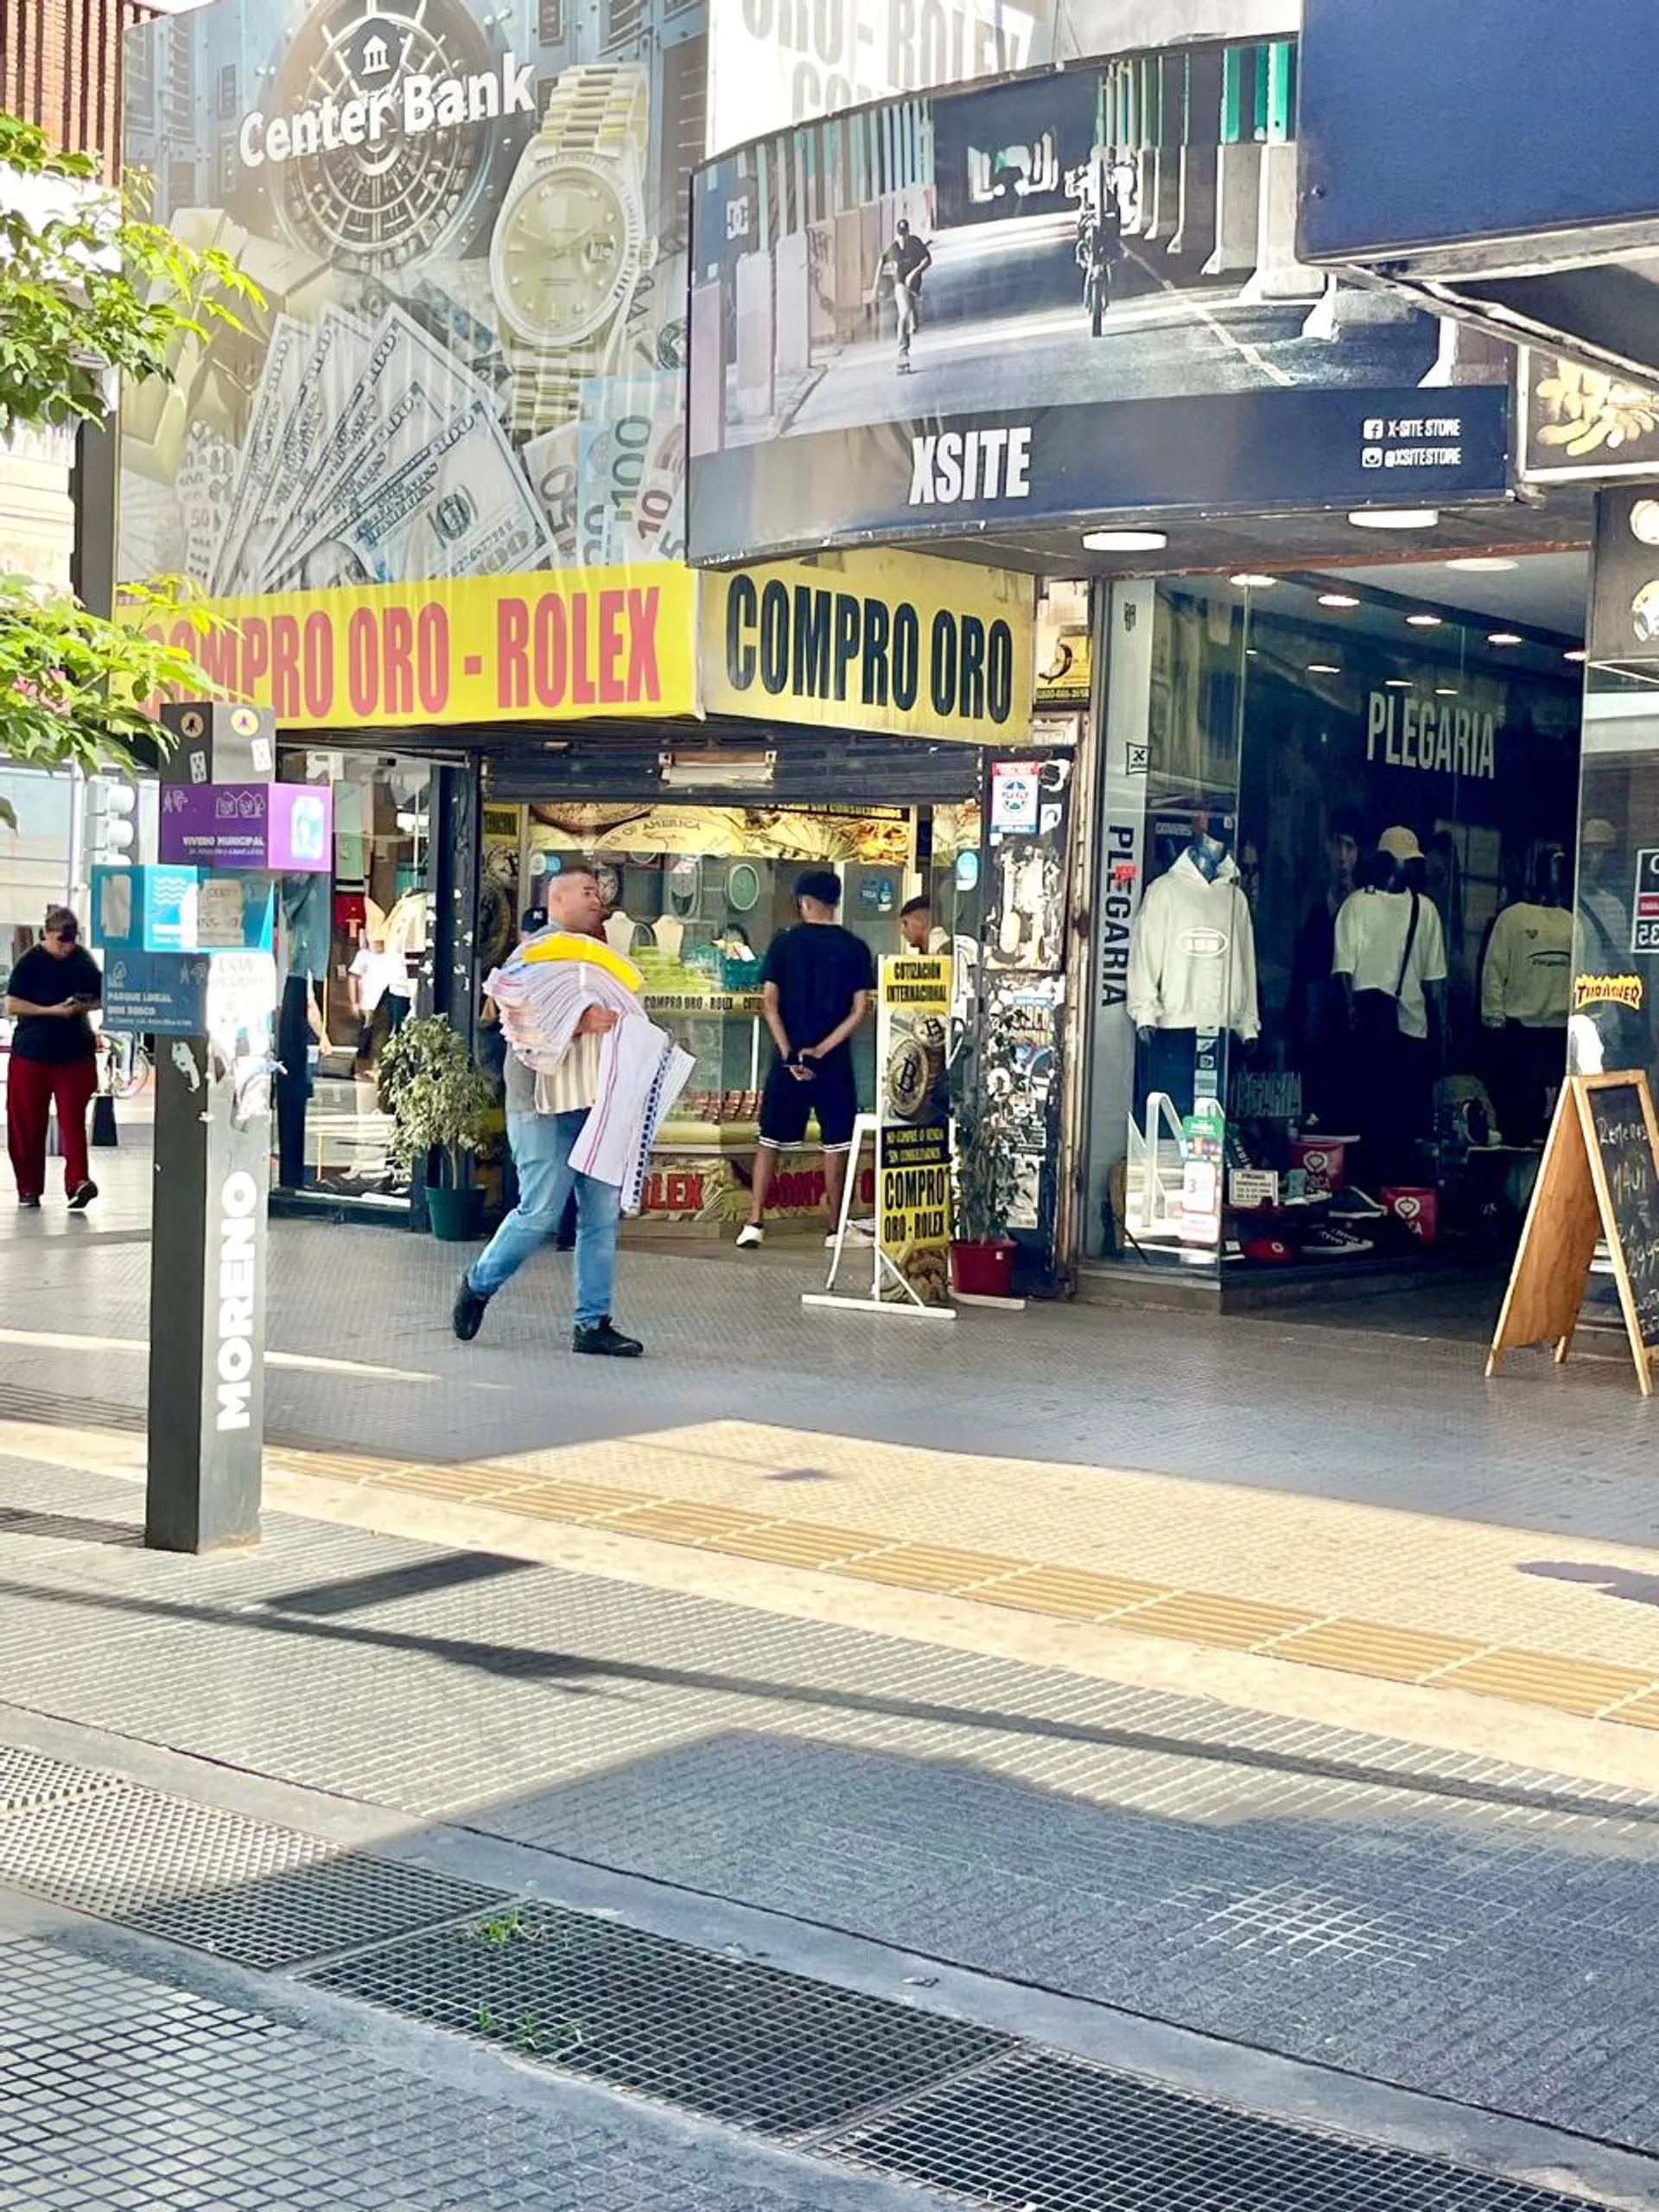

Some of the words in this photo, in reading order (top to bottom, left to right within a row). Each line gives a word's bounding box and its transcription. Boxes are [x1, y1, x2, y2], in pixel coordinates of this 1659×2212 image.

[239, 87, 393, 167] Center
[404, 53, 536, 133] Bank
[909, 427, 1031, 505] XSITE
[1388, 418, 1423, 438] X-SITE
[1425, 418, 1461, 437] STORE
[348, 601, 448, 717] ORO
[464, 655, 482, 675] -
[498, 587, 661, 709] ROLEX
[727, 574, 918, 711] COMPRO
[931, 609, 1013, 724] ORO
[1367, 691, 1494, 779] PLEGARIA
[643, 818, 702, 831] AMERICA
[1102, 825, 1135, 1007] PLEGARIA
[1577, 982, 1641, 1007] THRASHER
[885, 1168, 944, 1211] COMPRO
[885, 1215, 906, 1243] ORO
[914, 1211, 944, 1239] ROLEX
[217, 1172, 257, 1431] MORENO
